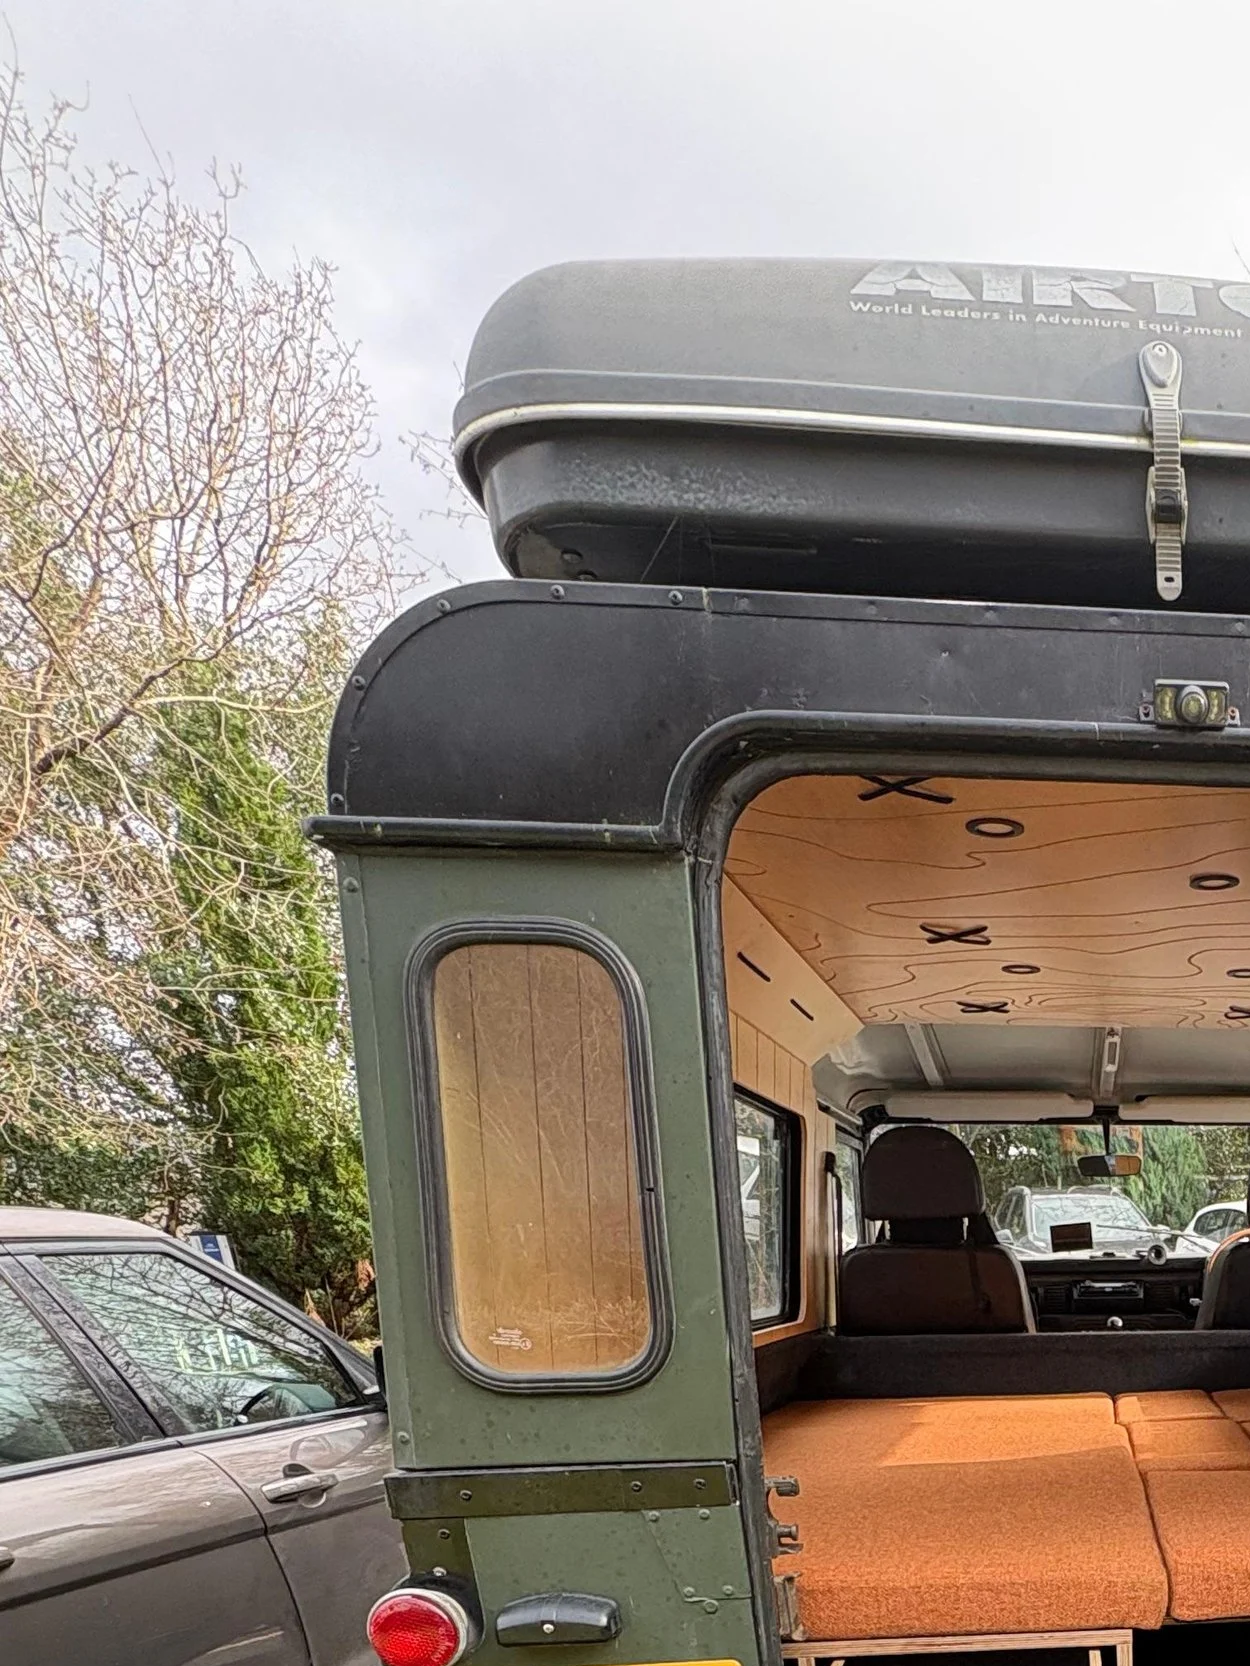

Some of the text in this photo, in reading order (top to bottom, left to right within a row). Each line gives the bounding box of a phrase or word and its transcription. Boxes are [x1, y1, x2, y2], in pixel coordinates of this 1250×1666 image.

[850, 301, 913, 315] World
[921, 305, 1000, 321] Leaders
[1008, 309, 1027, 322] in
[1035, 312, 1131, 329] Adventure
